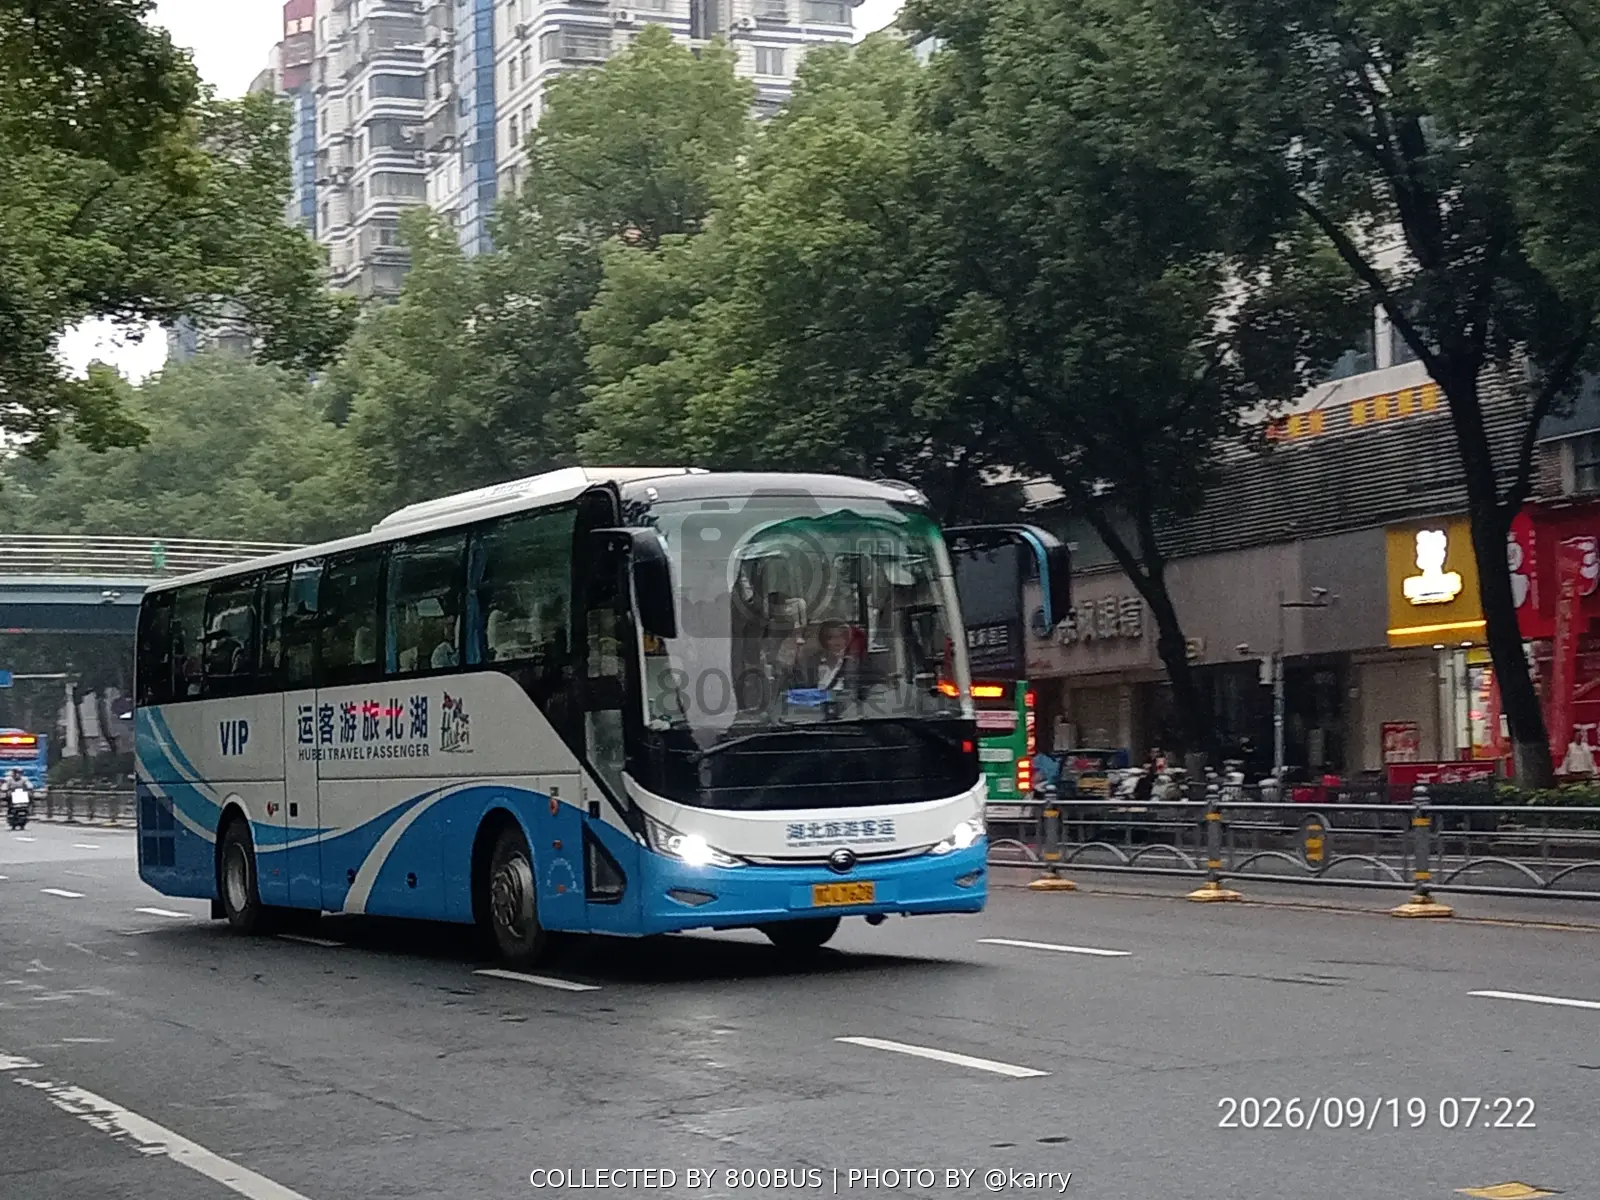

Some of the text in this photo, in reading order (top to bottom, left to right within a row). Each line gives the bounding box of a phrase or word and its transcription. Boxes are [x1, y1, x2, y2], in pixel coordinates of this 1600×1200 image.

[219, 719, 249, 756] VIP
[298, 743, 430, 761] HUBEI TRAVEL PASSENGER
